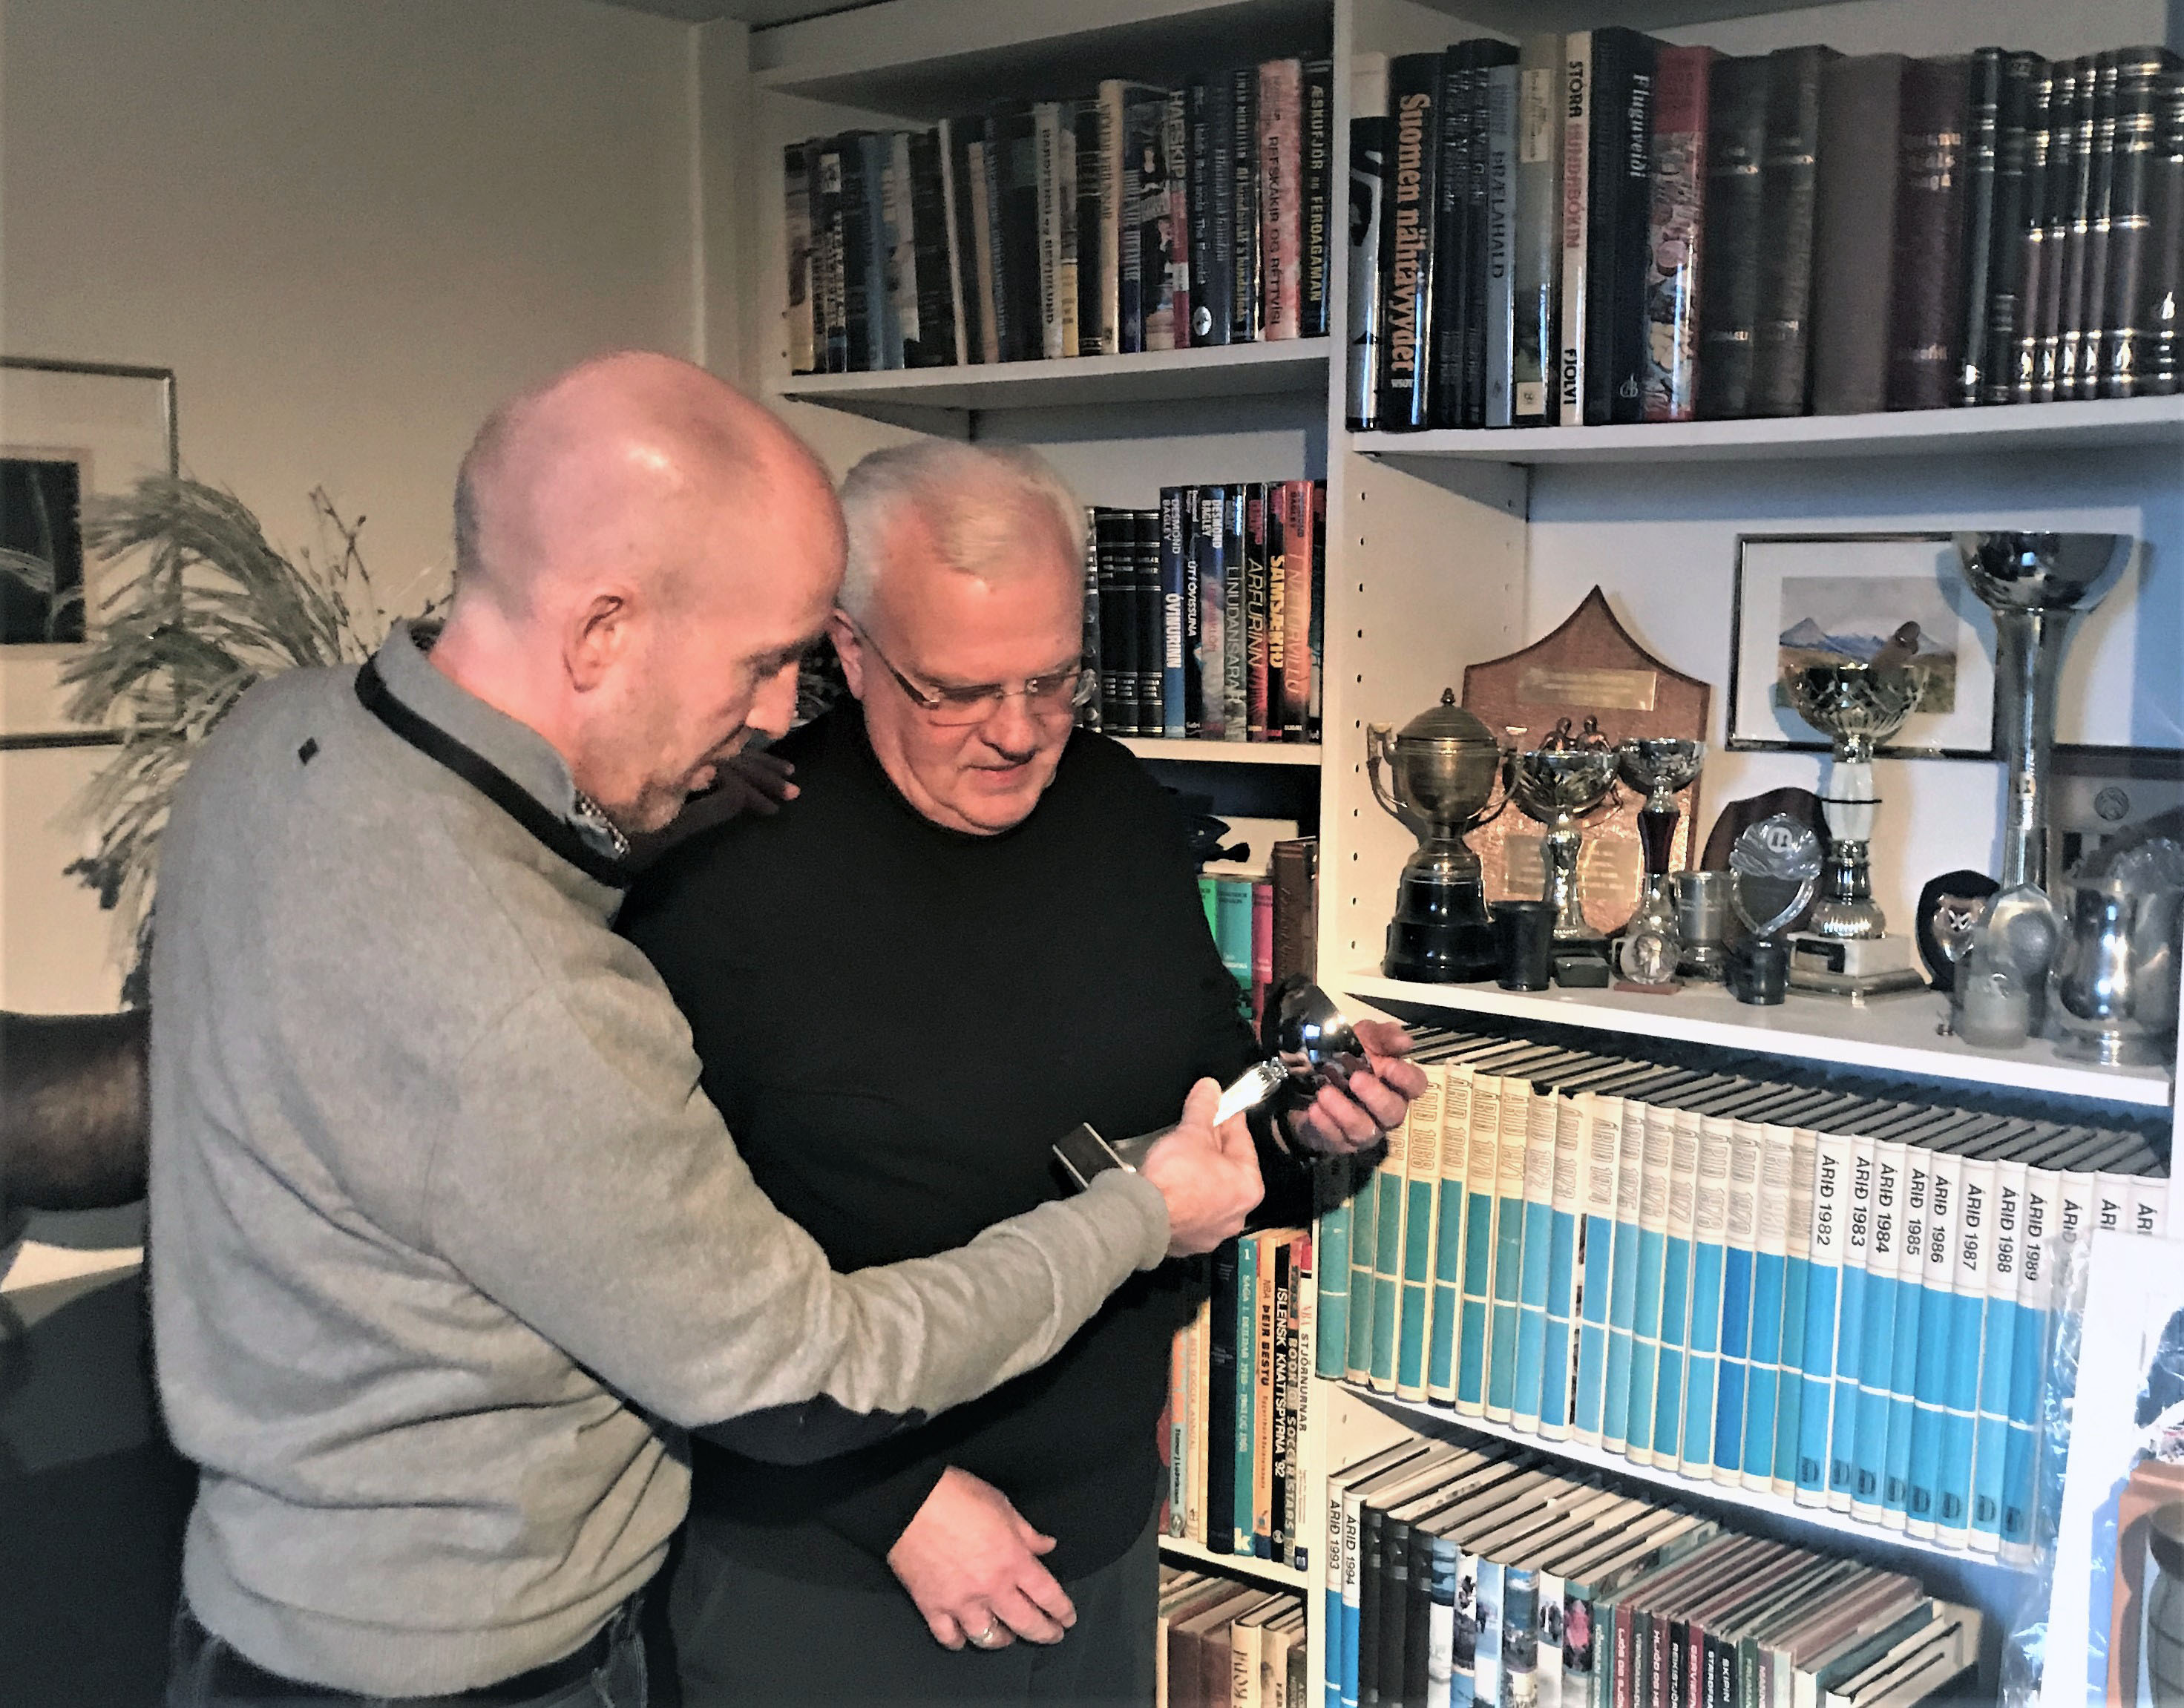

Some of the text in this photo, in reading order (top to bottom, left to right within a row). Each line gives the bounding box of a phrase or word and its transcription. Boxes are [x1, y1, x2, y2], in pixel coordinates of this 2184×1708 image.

[1569, 61, 1587, 117] STÓRA
[1627, 74, 1650, 178] Fluguveiði
[1388, 93, 1431, 370] Suomen nähtävyydet
[1163, 499, 1172, 540] BAGLEY
[1172, 499, 1181, 554] DESMOND
[1201, 500, 1212, 536] BAGLEY
[1212, 500, 1223, 548] DESMOND
[1166, 594, 1184, 668] ÓVINURINN
[1248, 559, 1264, 669] ARFURINN
[1269, 555, 1285, 668] SAMSÆRIÐ
[1411, 1129, 1436, 1170] 1968
[1817, 1204, 1832, 1246] 1982
[1851, 1206, 1867, 1246] 1983
[1875, 1213, 1892, 1253] 1984
[2100, 1198, 2121, 1230] ÁRI
[2137, 1203, 2157, 1235] ÁRI
[1906, 1219, 1922, 1255] 1985
[1930, 1226, 1945, 1263] 1986
[1963, 1233, 1978, 1271] 1987
[1997, 1237, 2014, 1273] 1988
[2025, 1244, 2041, 1281] 1989
[1262, 1305, 1271, 1338] ÞEIR
[1261, 1342, 1270, 1386] BESTU
[1288, 1338, 1298, 1382] BOOK
[1275, 1353, 1287, 1454] KNATTSPYRNA
[1299, 1333, 1311, 1433] STJÖRNURNAR
[1286, 1416, 1296, 1476] SOCCER
[1285, 1480, 1296, 1530] STARS
[1330, 1540, 1340, 1570] 1993
[1346, 1556, 1356, 1585] 1994
[1722, 1658, 1730, 1702] SKIPIN
